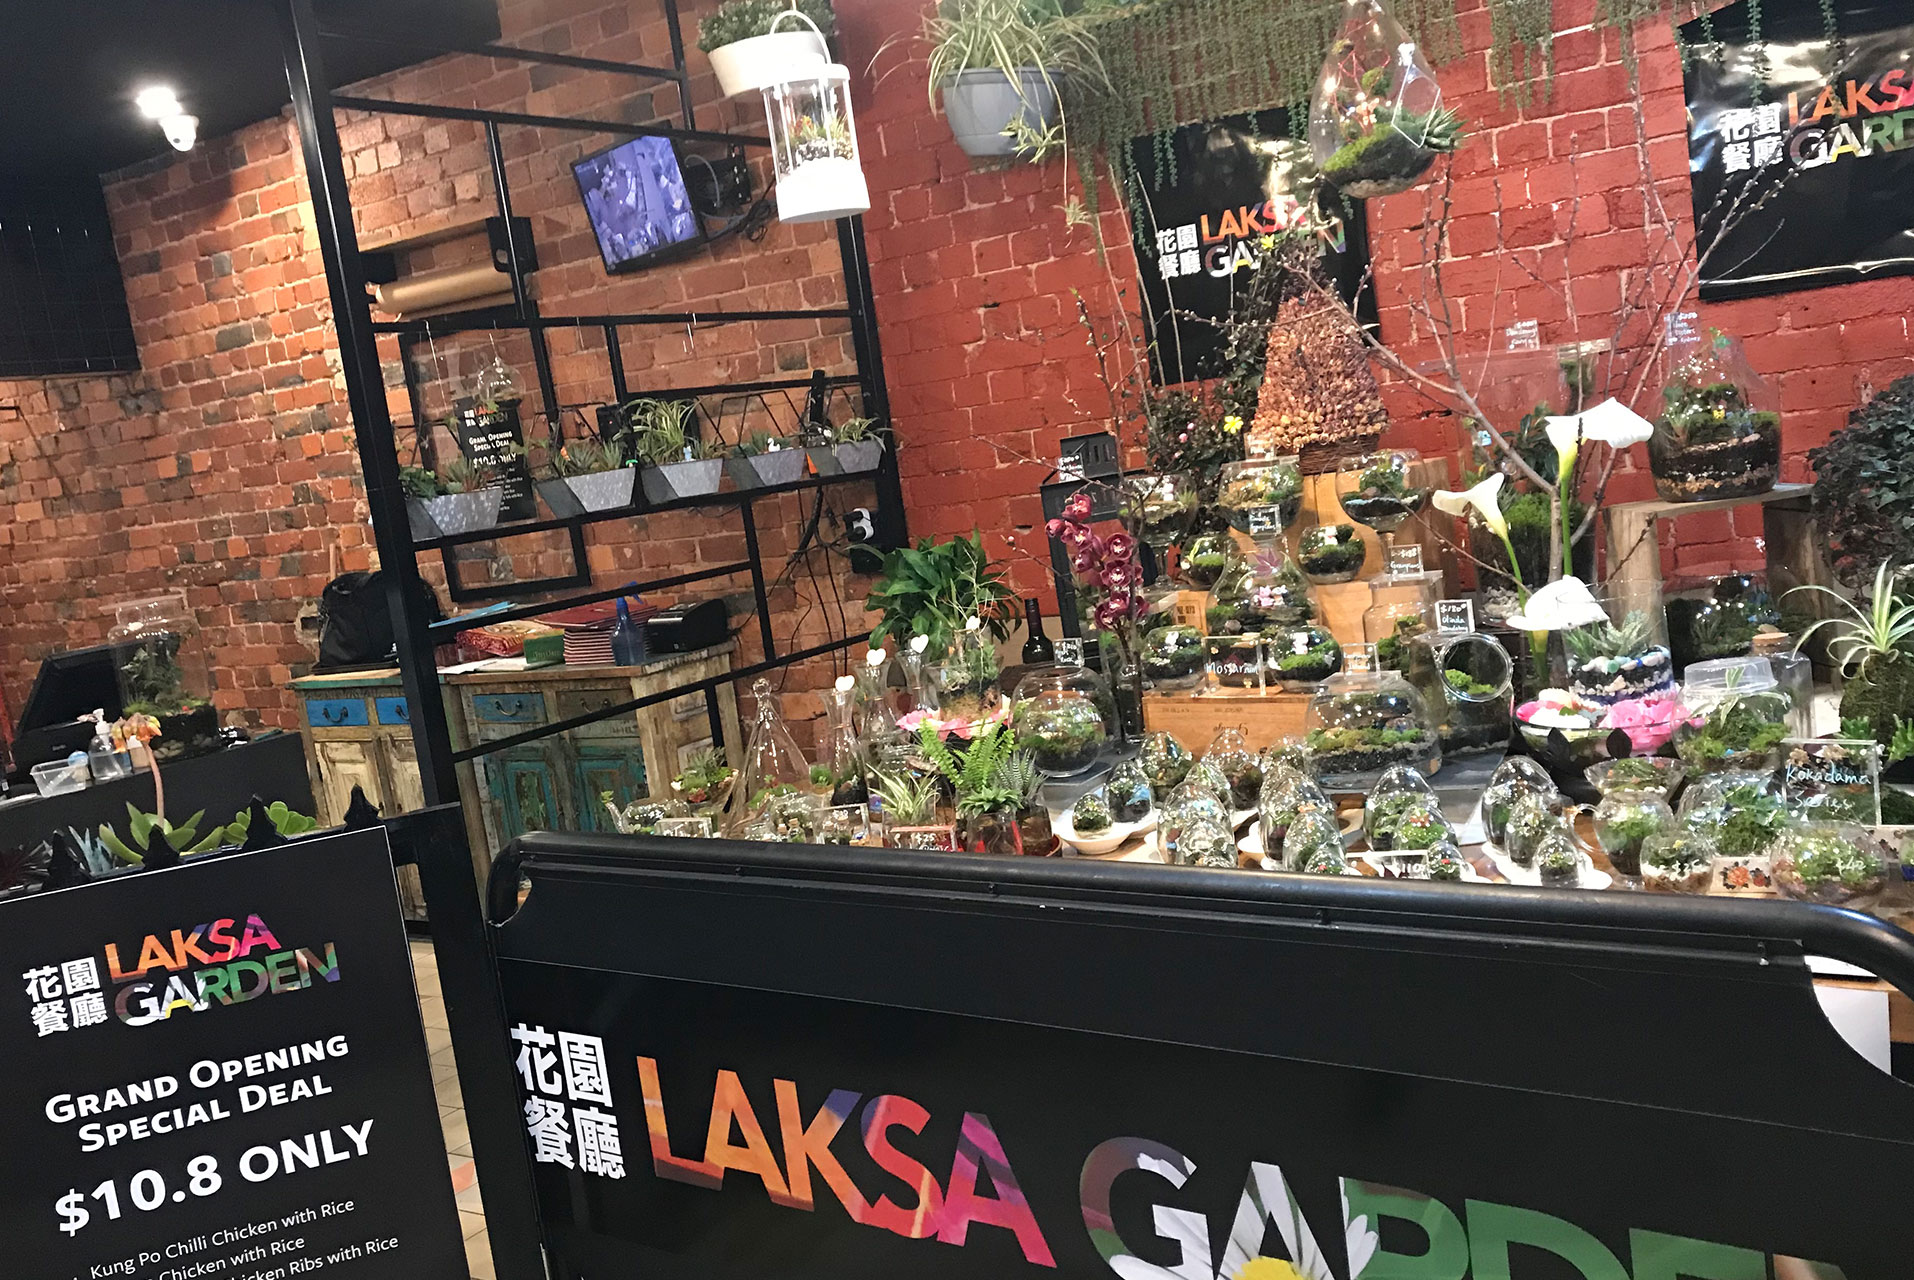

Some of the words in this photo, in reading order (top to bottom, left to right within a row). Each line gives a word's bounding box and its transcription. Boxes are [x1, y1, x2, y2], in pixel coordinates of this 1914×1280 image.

[1788, 69, 1914, 126] LAKS
[1205, 216, 1346, 277] GAN
[22, 956, 101, 1002] 花園
[105, 913, 282, 979] LAKSA
[114, 942, 341, 1026] GARDEN
[30, 991, 108, 1037] 餐廳
[45, 1074, 179, 1124] GRAND
[189, 1035, 349, 1088] OPENING
[511, 1022, 612, 1106] 花園
[79, 1098, 230, 1152] SPECIAL
[239, 1074, 332, 1114] DEAL
[524, 1095, 626, 1180] 餐廳
[55, 1154, 222, 1237] $10.8
[239, 1119, 374, 1182] ONLY
[636, 1056, 1057, 1268] LAKSA
[1079, 1136, 1847, 1280] GARD
[90, 1257, 135, 1280] Kung
[138, 1250, 161, 1268] Po
[165, 1236, 208, 1260] Chilli
[212, 1219, 278, 1247] Chicken
[281, 1207, 317, 1229] with
[321, 1199, 355, 1221] Rice
[159, 1256, 227, 1280] Chicken
[230, 1246, 267, 1268] with
[270, 1236, 306, 1258] Rice
[231, 1265, 285, 1280] icken
[289, 1254, 324, 1274] Ribs
[326, 1244, 362, 1265] with
[365, 1235, 399, 1257] Rice
